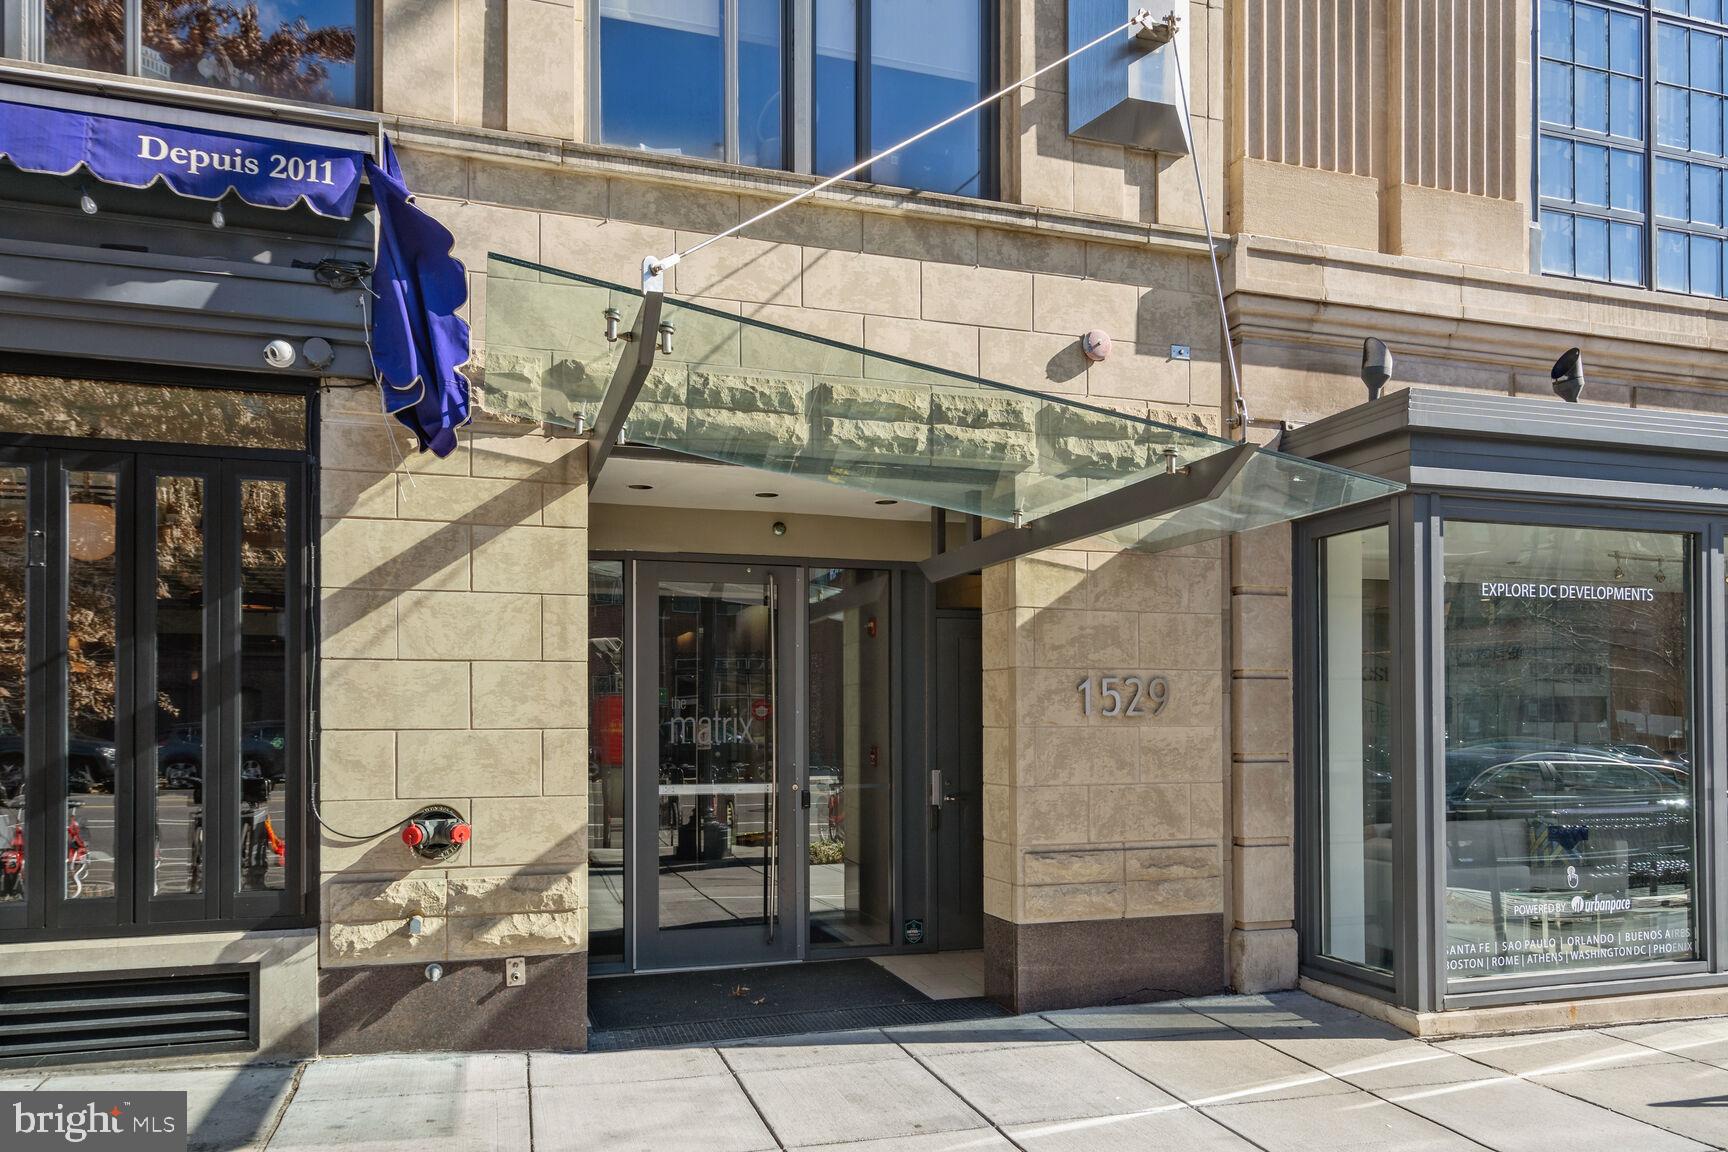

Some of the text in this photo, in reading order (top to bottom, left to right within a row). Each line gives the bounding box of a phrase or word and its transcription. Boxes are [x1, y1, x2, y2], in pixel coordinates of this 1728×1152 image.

[137, 135, 335, 185] Depuis 2011
[1481, 583, 1654, 601] EXPLORE DC DEVELOPMENTS
[671, 696, 686, 710] the
[1077, 677, 1169, 717] 1529
[670, 709, 754, 744] matrix
[1514, 895, 1631, 915] POWERED BY urbanpace
[1479, 942, 1490, 953] FE
[1502, 940, 1522, 952] SAO
[1524, 938, 1556, 949] PAULO
[1567, 933, 1615, 946] ORLANDO
[1625, 930, 1663, 942] BUENOS
[1664, 927, 1691, 939] AIRES
[1491, 955, 1520, 967] ROME
[1526, 952, 1563, 964] ATHENS
[1570, 946, 1632, 960] WASHINGTON
[1634, 944, 1647, 956] DC
[1653, 942, 1693, 953] PHOENIX
